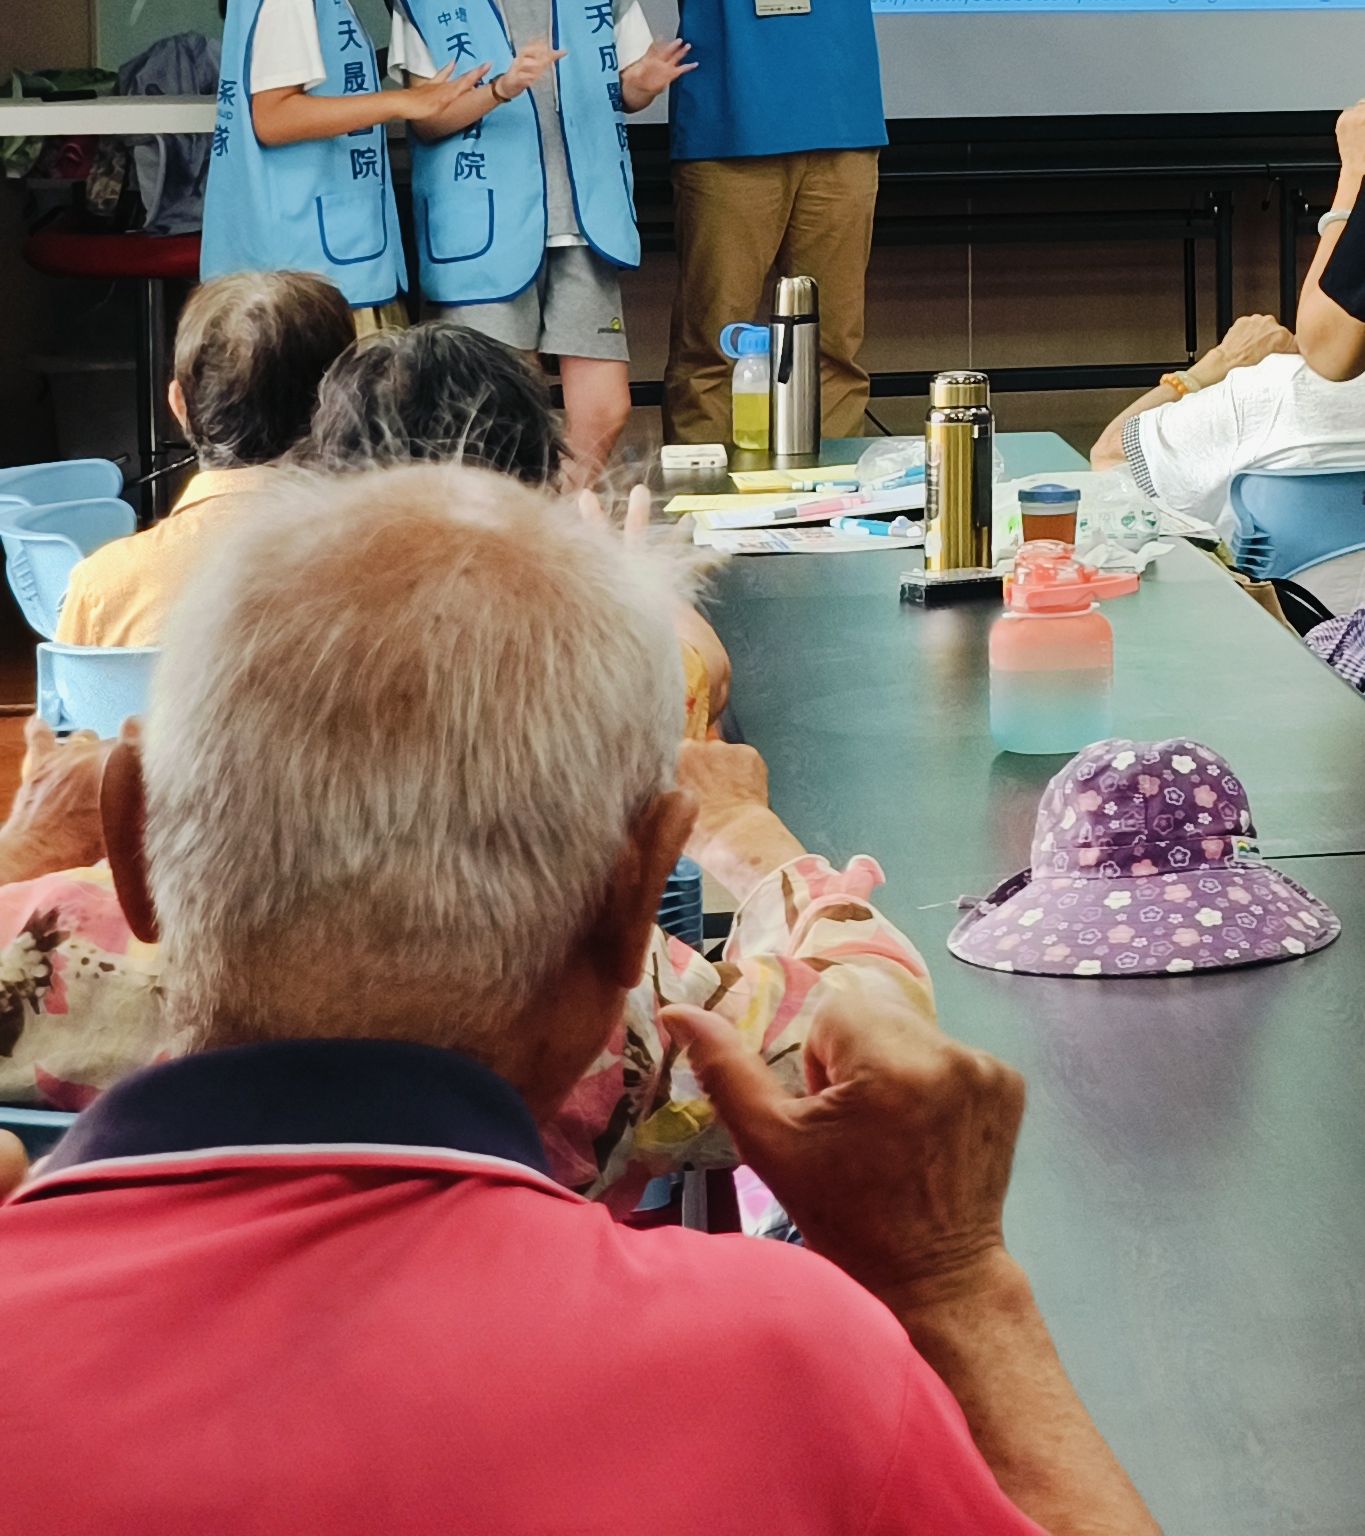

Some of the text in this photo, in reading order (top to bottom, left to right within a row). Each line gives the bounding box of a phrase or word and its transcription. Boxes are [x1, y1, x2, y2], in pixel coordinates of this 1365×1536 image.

[338, 20, 380, 180] 天晟院
[446, 32, 487, 181] 天院
